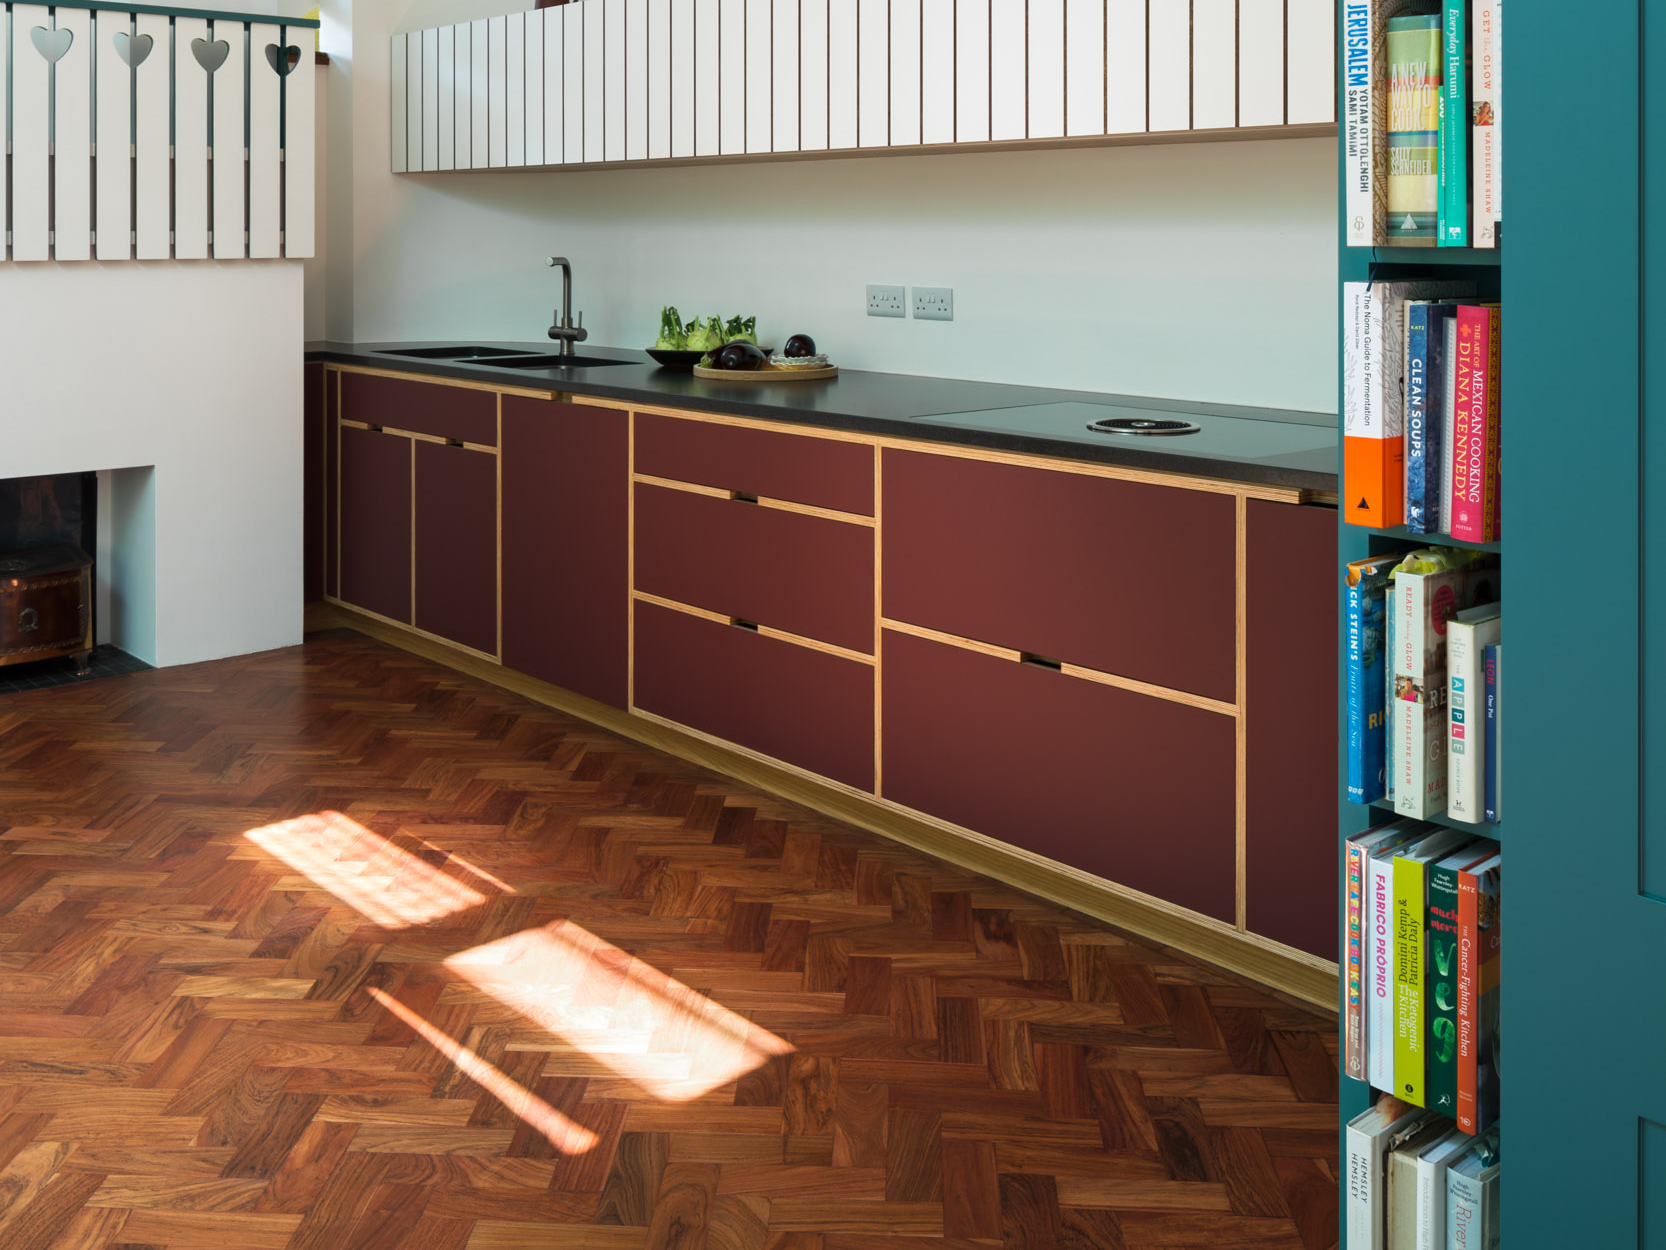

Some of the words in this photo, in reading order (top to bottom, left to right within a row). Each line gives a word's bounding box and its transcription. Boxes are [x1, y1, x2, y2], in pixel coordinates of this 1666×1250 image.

[1347, 4, 1369, 87] JERUSALEM
[1447, 8, 1460, 54] Everyday
[1391, 63, 1399, 86] A
[1400, 61, 1427, 87] NEW
[1449, 56, 1460, 99] Harumi
[1483, 54, 1491, 90] GLOW
[1349, 90, 1357, 115] SAMI
[1360, 89, 1368, 124] YOTAM
[1391, 85, 1414, 109] WAY
[1415, 84, 1431, 109] TO
[1349, 119, 1357, 157] TAMIMI
[1391, 147, 1411, 162] SALLY
[1360, 128, 1369, 193] OTTOLENGHI
[1391, 159, 1432, 175] SCHNEIDER
[1364, 294, 1372, 310] The
[1364, 311, 1372, 335] Noma
[1364, 337, 1372, 361] Guide
[1364, 362, 1372, 371] to
[1473, 357, 1480, 368] OF
[1411, 358, 1422, 405] CLEAN
[1458, 341, 1471, 403] DIANA
[1364, 373, 1372, 427] Fermentation
[1471, 370, 1483, 435] MEXICAN
[1411, 410, 1422, 457] SOUPS
[1455, 409, 1469, 502] KENNEDY
[1469, 437, 1482, 503] COOKING
[1350, 586, 1358, 609] ICK
[1350, 613, 1358, 661] STEIN'S
[1486, 658, 1495, 685] LEON
[1453, 678, 1463, 753] APPLE
[1350, 849, 1359, 873] RIVER
[1437, 873, 1450, 881] Hugh
[1376, 874, 1386, 935] FABRICO
[1398, 898, 1407, 907] &
[1458, 883, 1475, 894] KATZ
[1350, 915, 1359, 947] COOK
[1398, 908, 1410, 941] Kemp
[1408, 918, 1420, 943] Daly
[1430, 906, 1458, 923] much
[1350, 948, 1359, 980] BOOK
[1376, 938, 1388, 998] PRÓPRIO
[1397, 942, 1408, 983] Domini
[1408, 945, 1418, 986] Patricia
[1459, 938, 1471, 1017] Cancer-Fighting
[1350, 981, 1360, 1012] EASY
[1397, 983, 1418, 999] The
[1433, 939, 1457, 1063] veg
[1399, 995, 1409, 1038] Kitchen
[1407, 998, 1420, 1053] Ketogenic
[1460, 1019, 1471, 1057] Kitchen
[1351, 1152, 1359, 1199] HEMSLEY
[1456, 1180, 1469, 1190] Hugh
[1456, 1204, 1472, 1248] River
